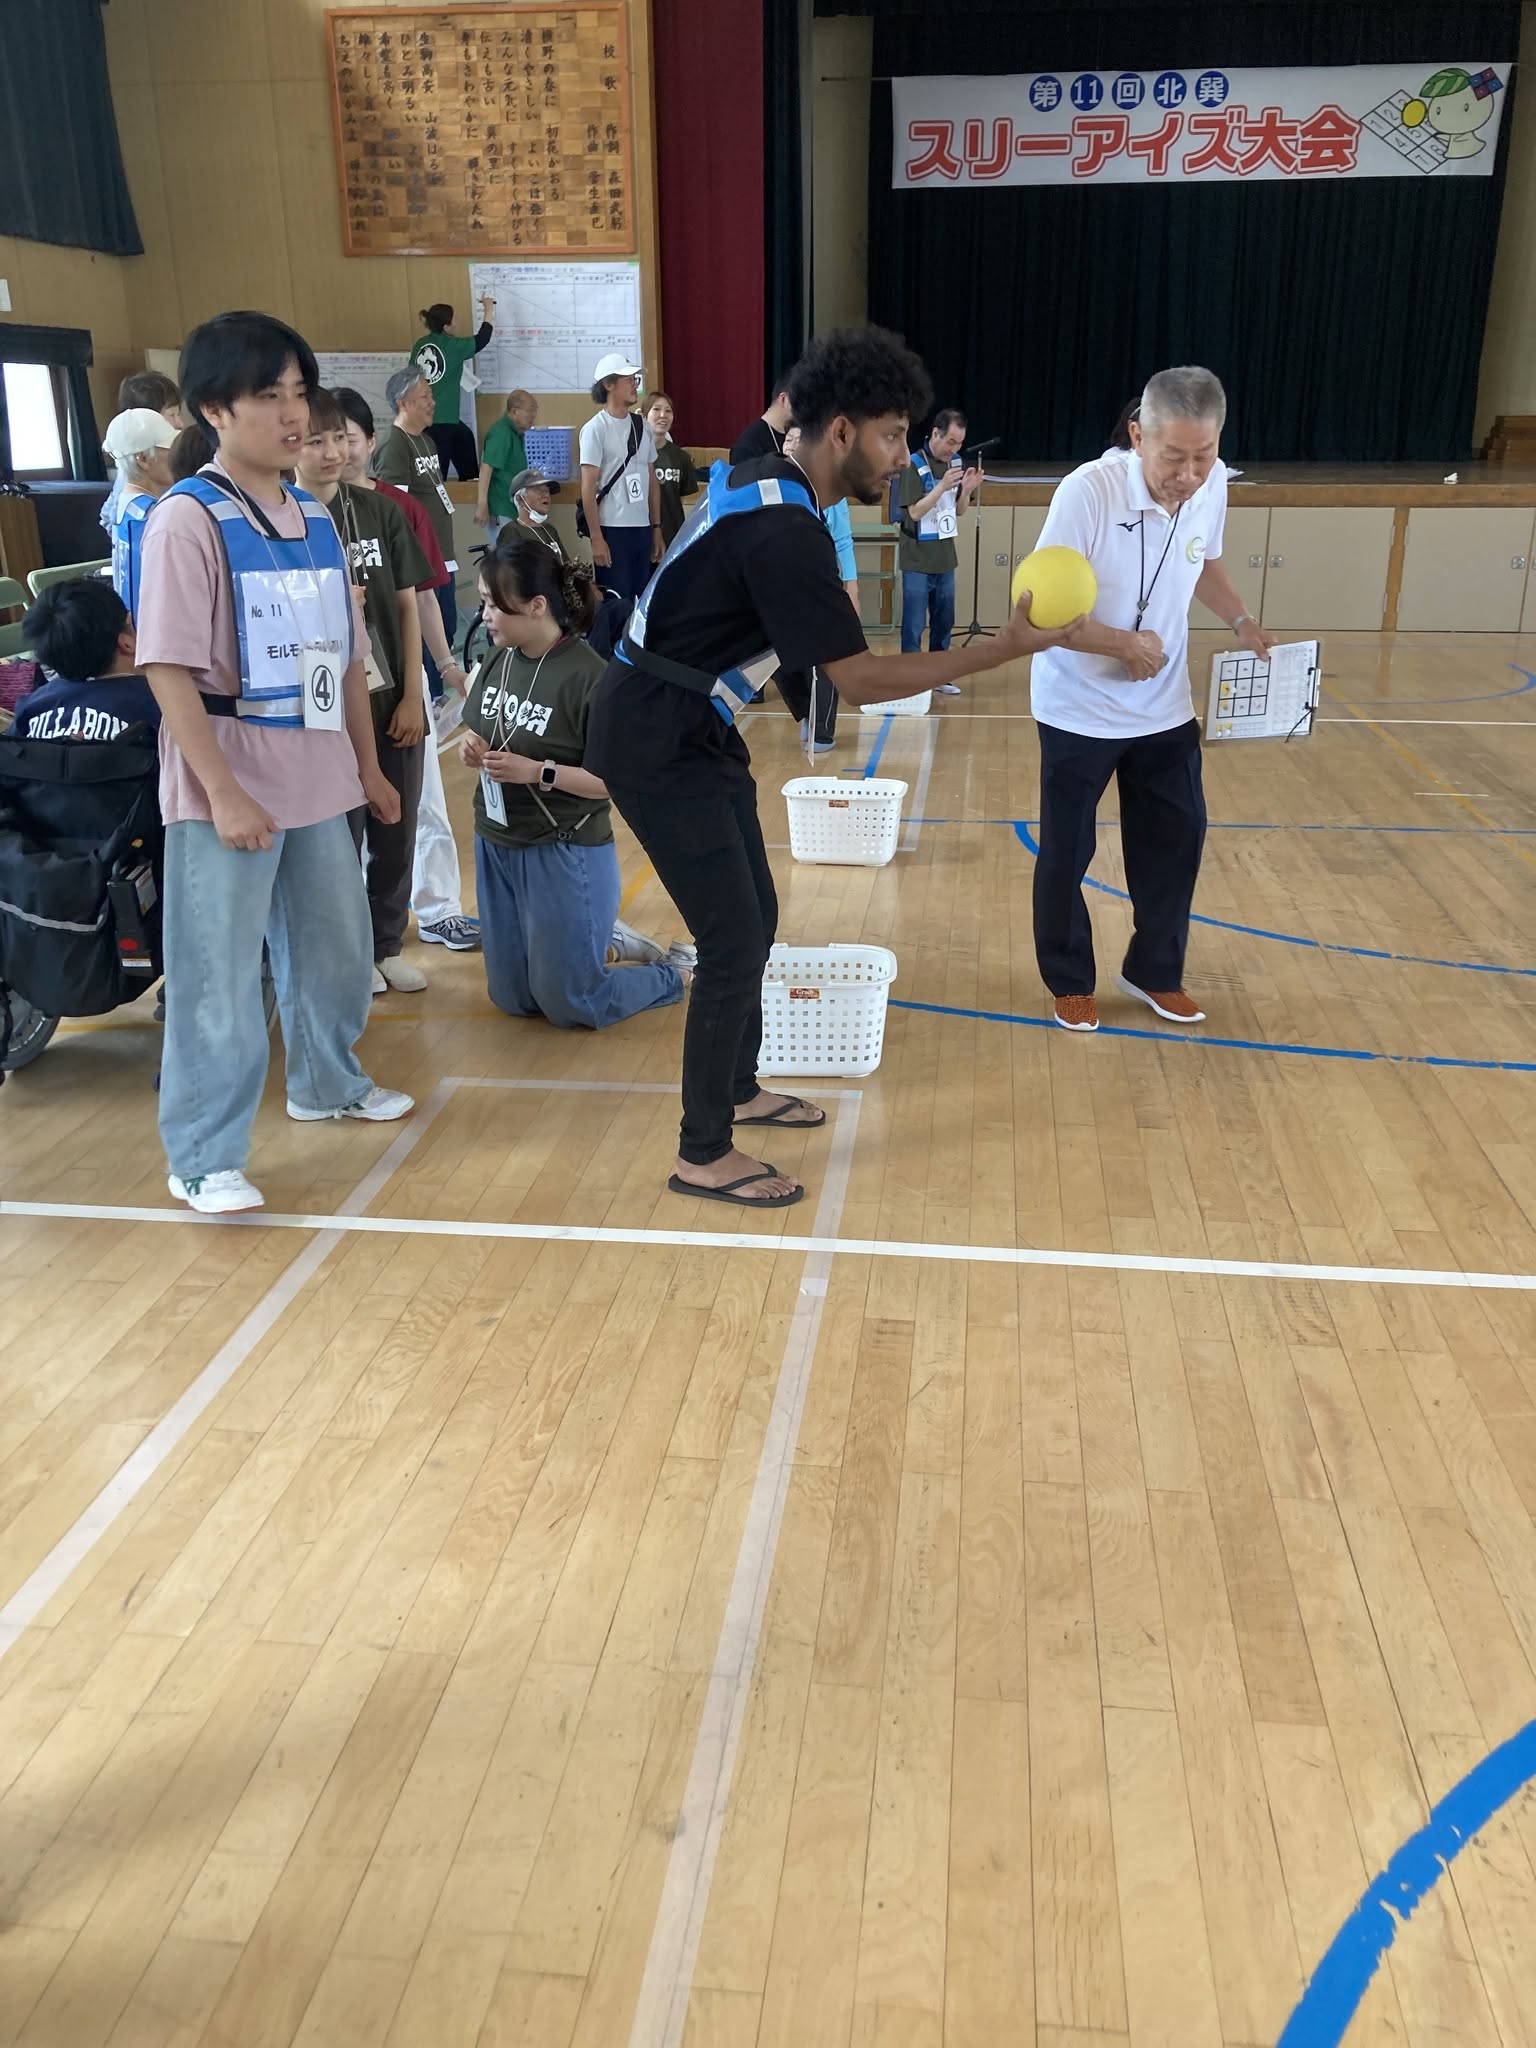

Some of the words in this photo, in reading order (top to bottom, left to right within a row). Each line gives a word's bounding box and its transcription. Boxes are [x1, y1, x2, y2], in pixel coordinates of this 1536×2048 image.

[500, 32, 518, 123] みんな元気に
[603, 43, 618, 91] 校歌
[1370, 119, 1384, 130] 1
[1384, 108, 1399, 121] 2
[587, 123, 600, 153] 作曲
[604, 123, 620, 154] 作詞
[907, 105, 1362, 180] スリーアイズ大会
[1393, 136, 1406, 148] 4
[271, 603, 282, 617] 11
[314, 667, 333, 709] 4
[481, 686, 553, 737] EPOCH
